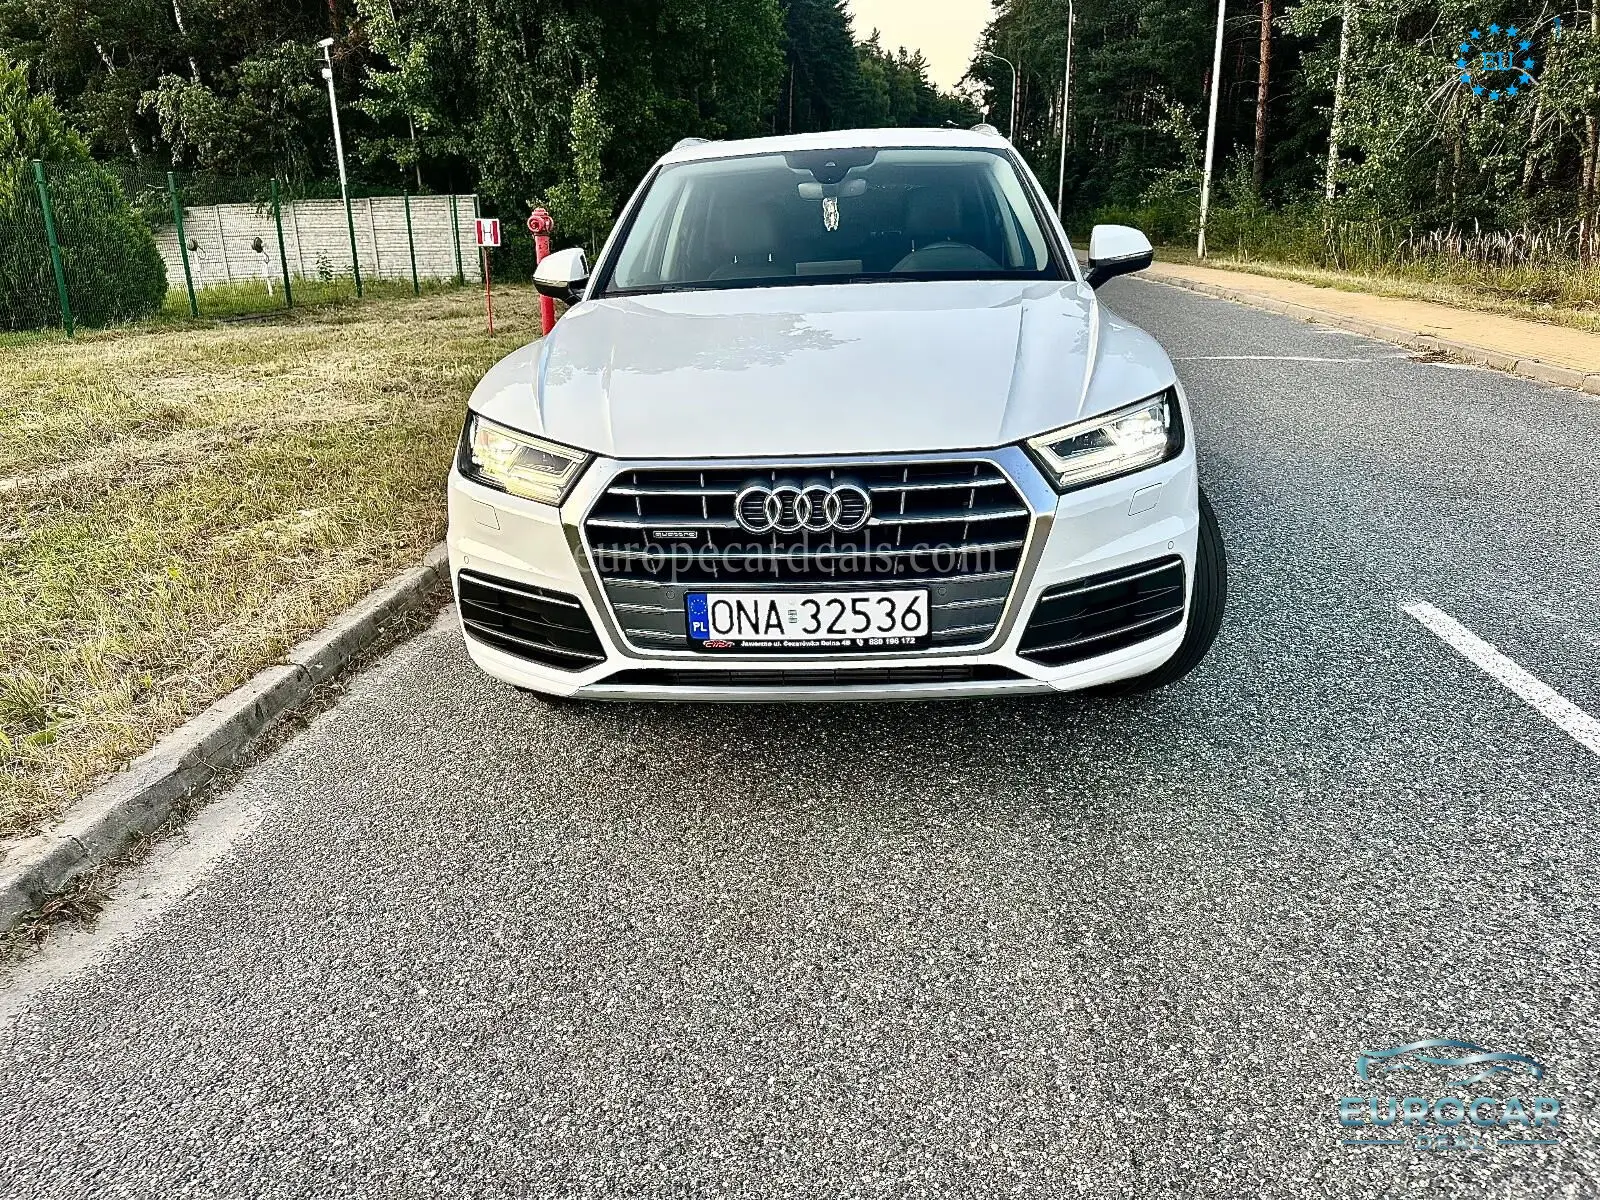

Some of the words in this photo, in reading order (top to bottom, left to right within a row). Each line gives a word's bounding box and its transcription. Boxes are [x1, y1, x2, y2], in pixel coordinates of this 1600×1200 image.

[693, 621, 708, 632] PL
[711, 599, 785, 635] ONA
[800, 595, 922, 635] 32536
